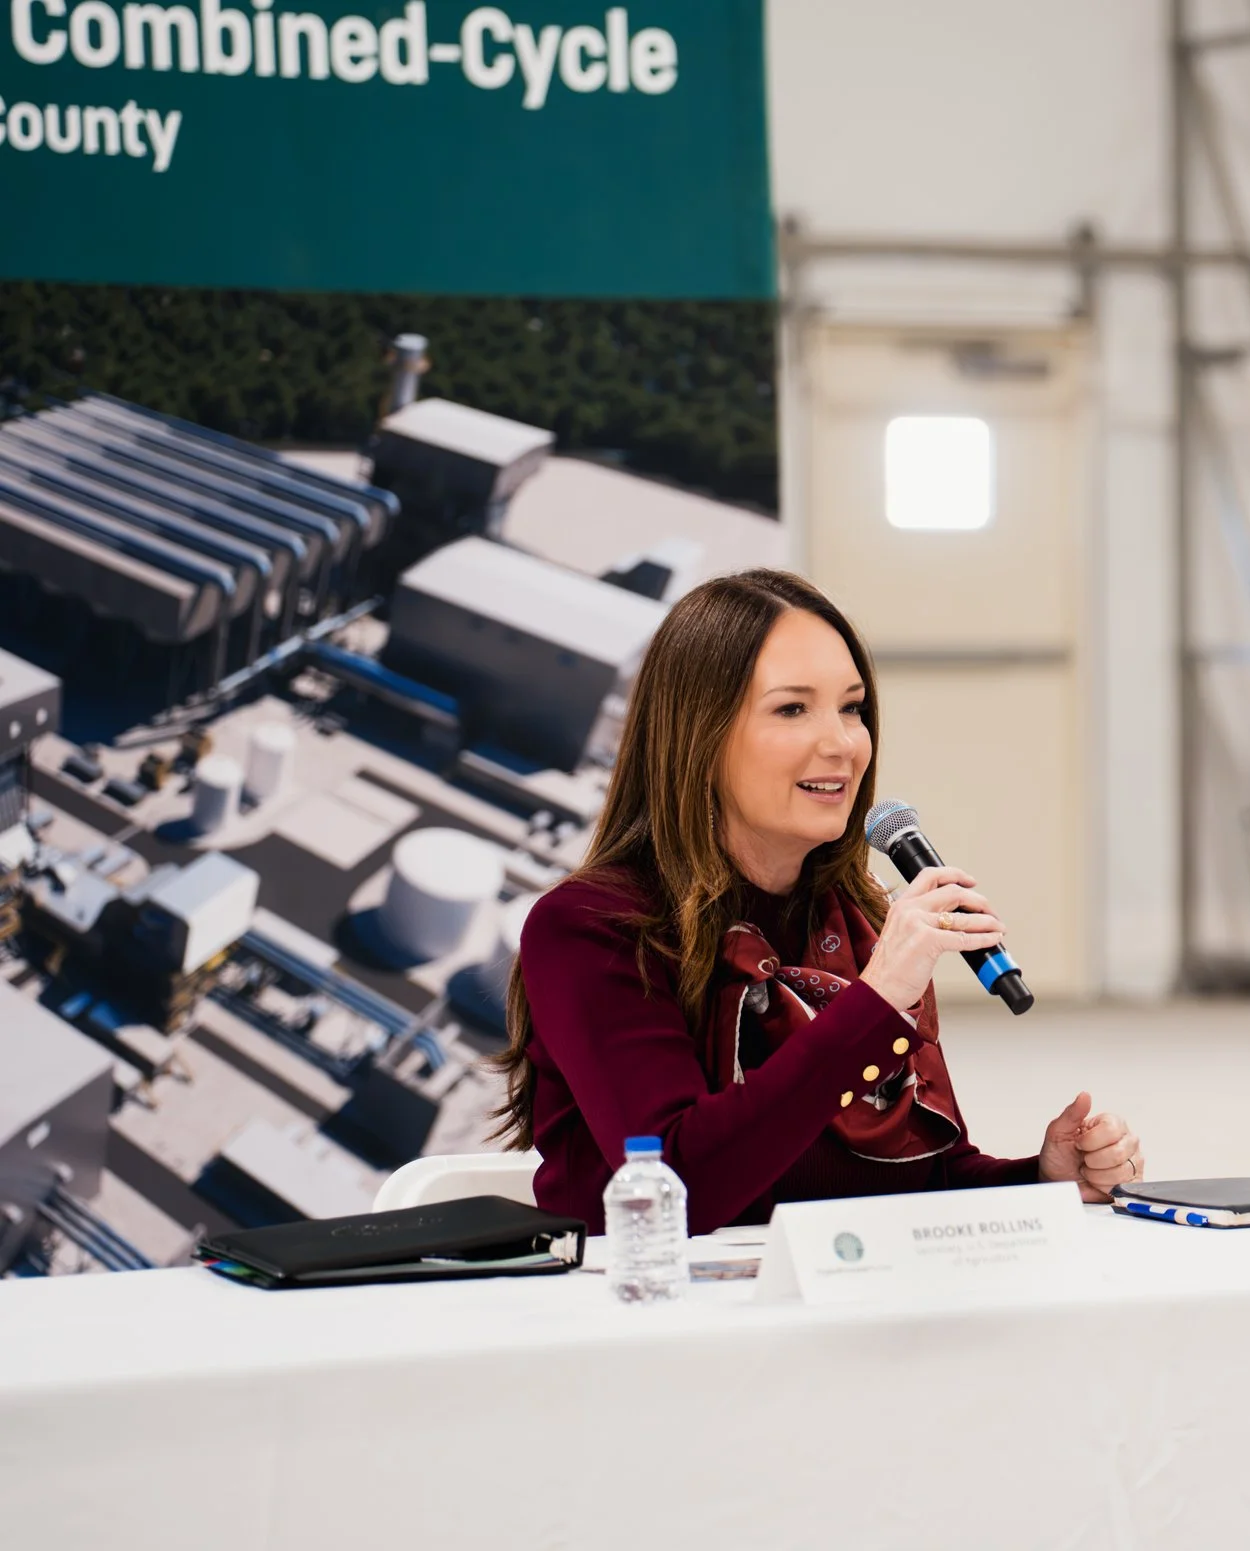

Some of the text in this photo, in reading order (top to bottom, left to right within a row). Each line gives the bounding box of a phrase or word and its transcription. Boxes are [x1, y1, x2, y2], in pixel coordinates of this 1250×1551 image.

[10, 0, 678, 109] Combined-Cycle
[0, 95, 182, 172] ounty
[912, 1217, 1044, 1241] BROOKE ROLLINS
